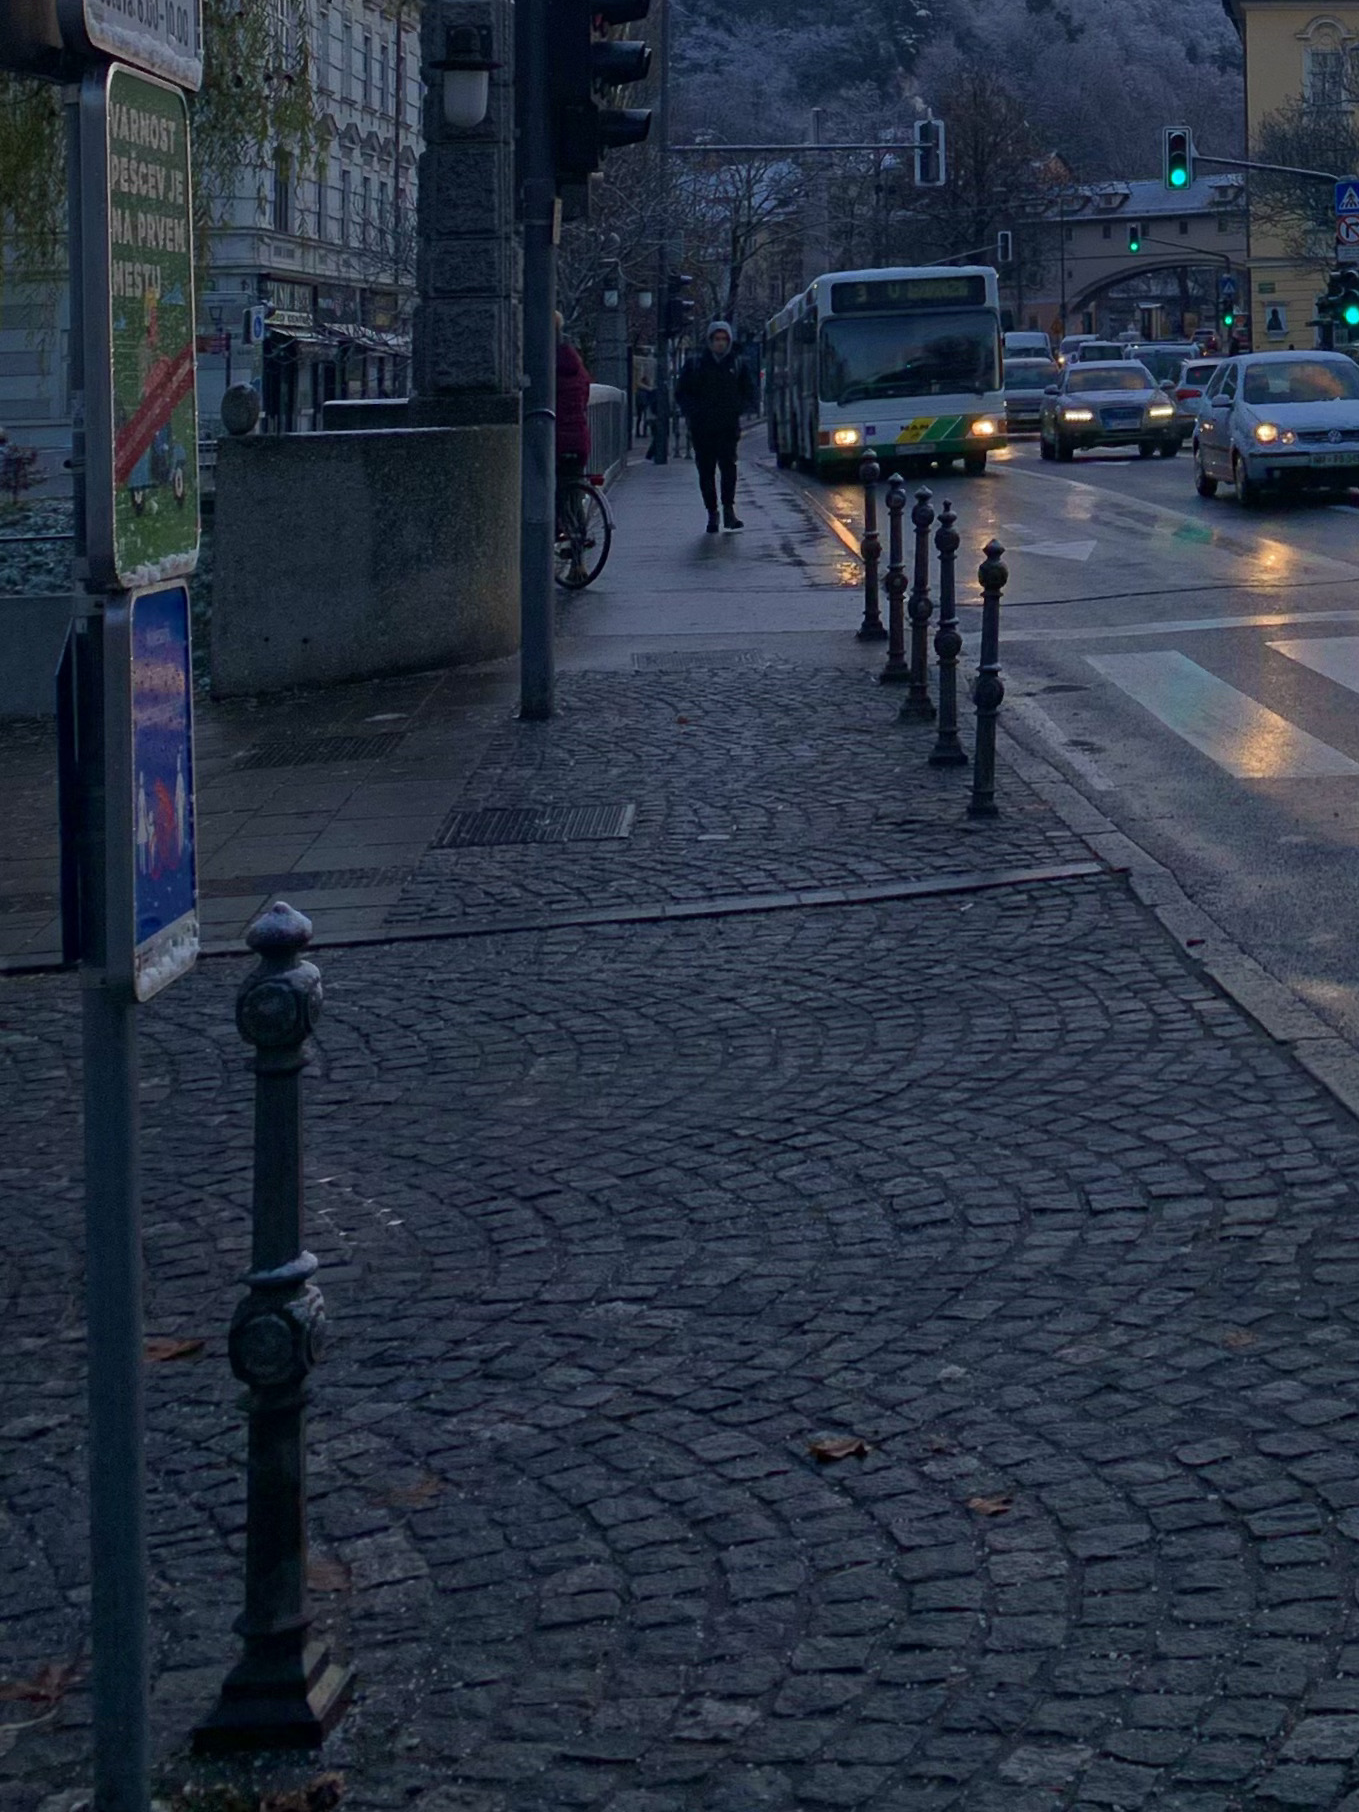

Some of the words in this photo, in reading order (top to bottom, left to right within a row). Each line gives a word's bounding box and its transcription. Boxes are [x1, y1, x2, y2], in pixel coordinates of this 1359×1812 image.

[109, 101, 176, 154] VARNOST
[110, 151, 165, 200] PEŠCEV
[168, 168, 185, 204] JE
[111, 206, 133, 245] NA
[137, 210, 187, 253] PRVEM
[113, 259, 161, 299] MESTU
